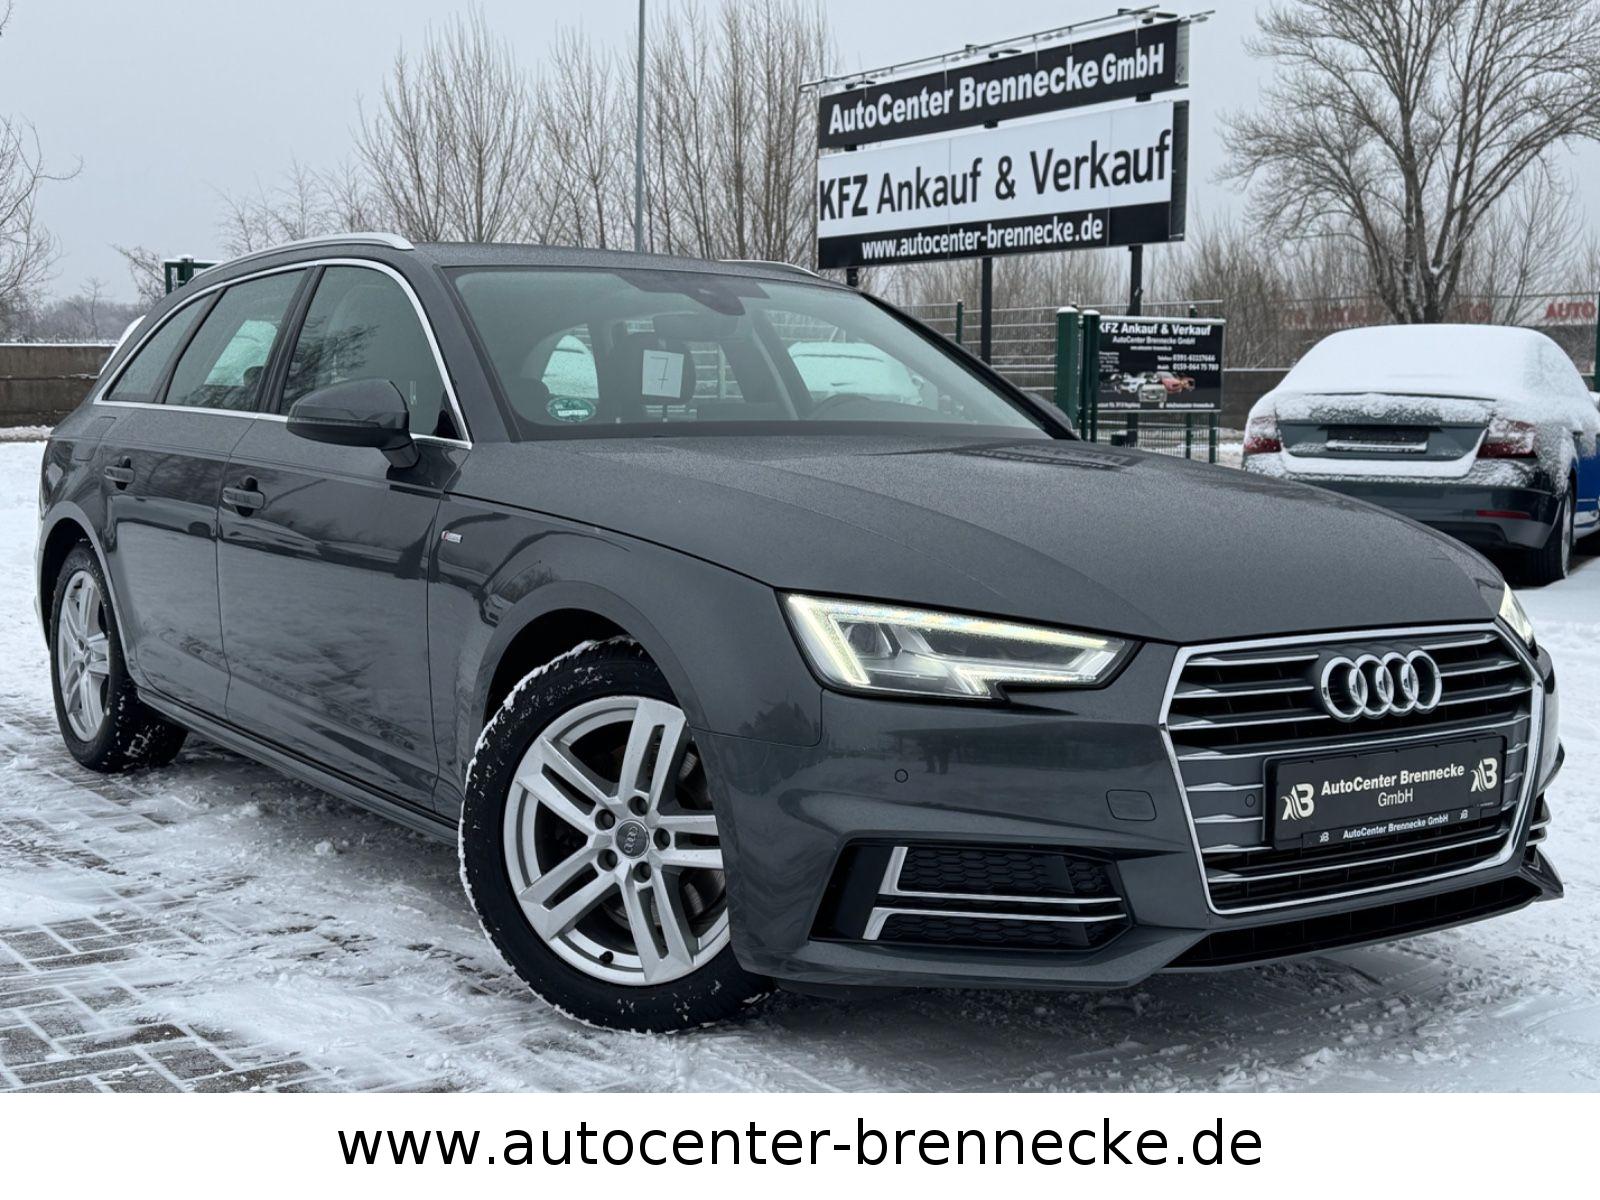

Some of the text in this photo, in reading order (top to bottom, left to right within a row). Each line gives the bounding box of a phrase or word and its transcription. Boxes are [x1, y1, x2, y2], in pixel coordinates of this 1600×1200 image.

[829, 43, 1164, 135] AutoCenter Brennecke GmbH
[819, 129, 1171, 221] KFZ Ankauf & Verkauf
[862, 212, 1103, 260] www.autocenter-brennecke.de
[1121, 323, 1158, 334] Ankauf
[1161, 324, 1169, 335] &
[1172, 324, 1211, 336] Verkauf
[1321, 763, 1465, 796] AutoCenter Brennecke
[1378, 788, 1414, 807] GmbH
[1343, 814, 1449, 839] AutoCenter Brennecke GmbH
